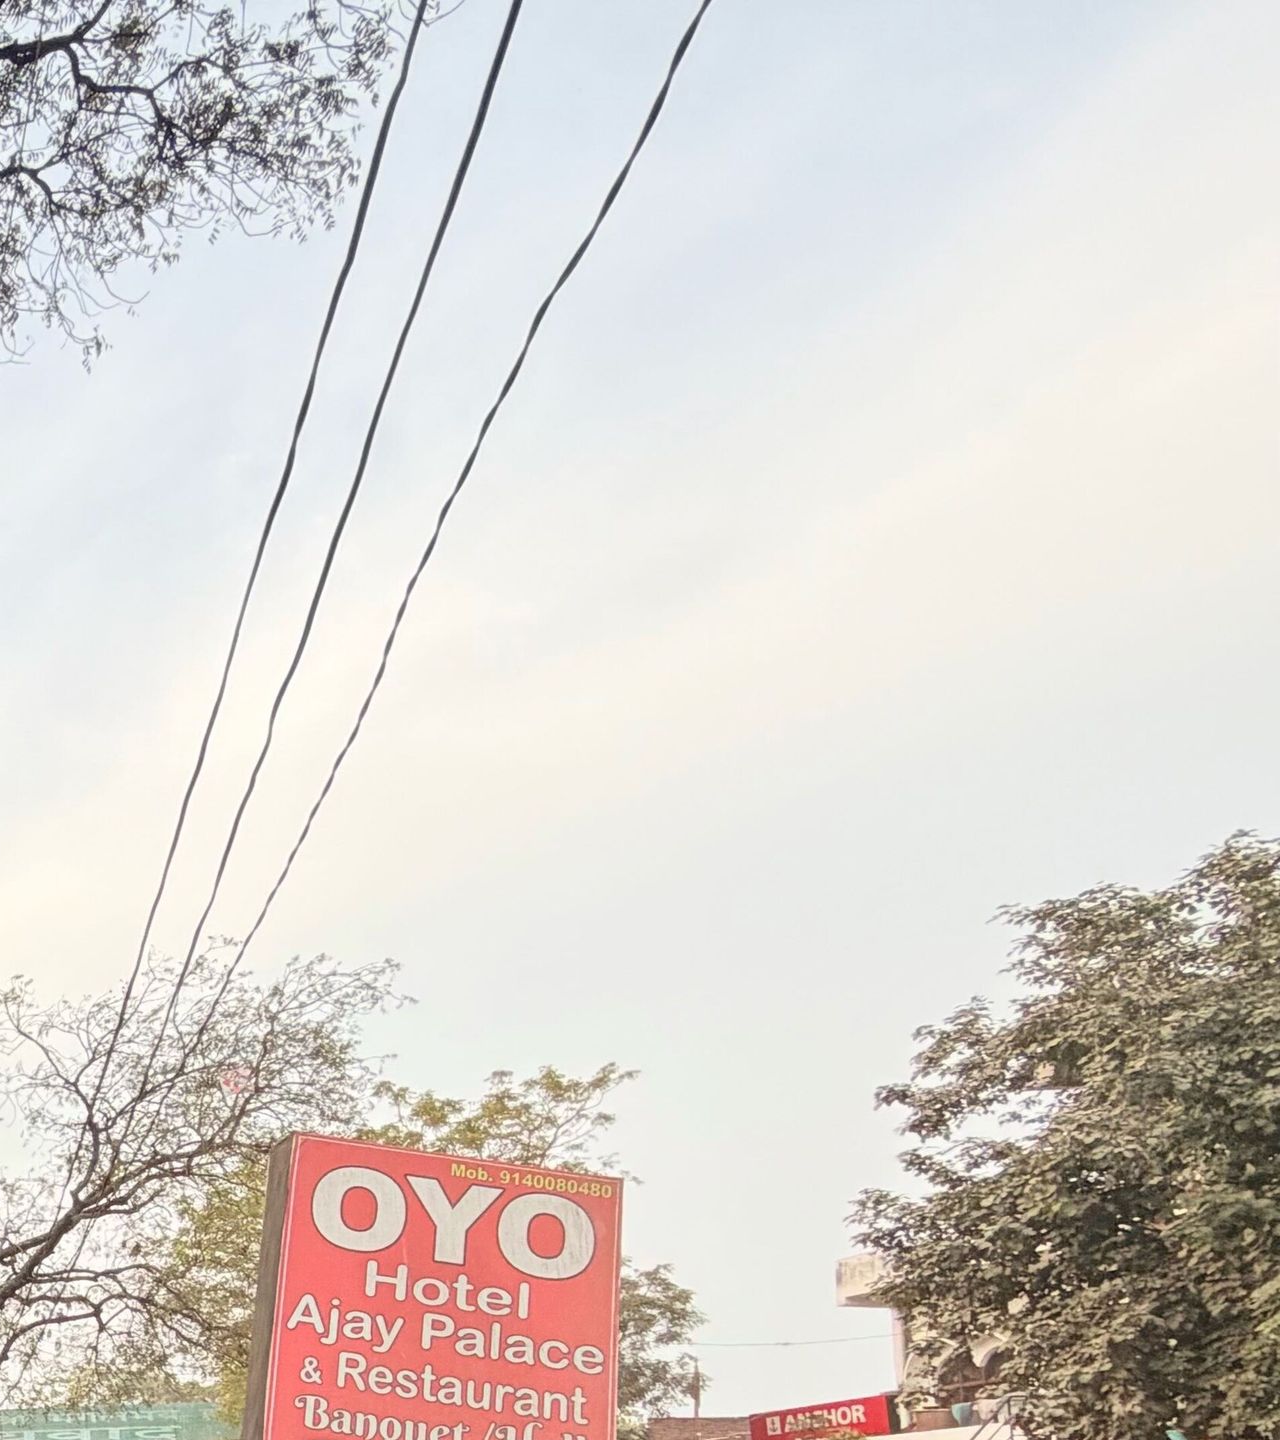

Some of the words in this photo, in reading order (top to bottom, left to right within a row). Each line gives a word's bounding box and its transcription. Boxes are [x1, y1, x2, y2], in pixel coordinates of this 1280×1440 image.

[451, 1163, 493, 1182] Mob.
[500, 1170, 613, 1199] 9140080480
[311, 1165, 596, 1280] OYO
[364, 1260, 529, 1320] Hotel
[287, 1293, 405, 1353] Ajay
[421, 1313, 604, 1374] Palace
[299, 1357, 322, 1385] &
[336, 1351, 589, 1425] Restaurant
[784, 1404, 866, 1432] ANCHOR
